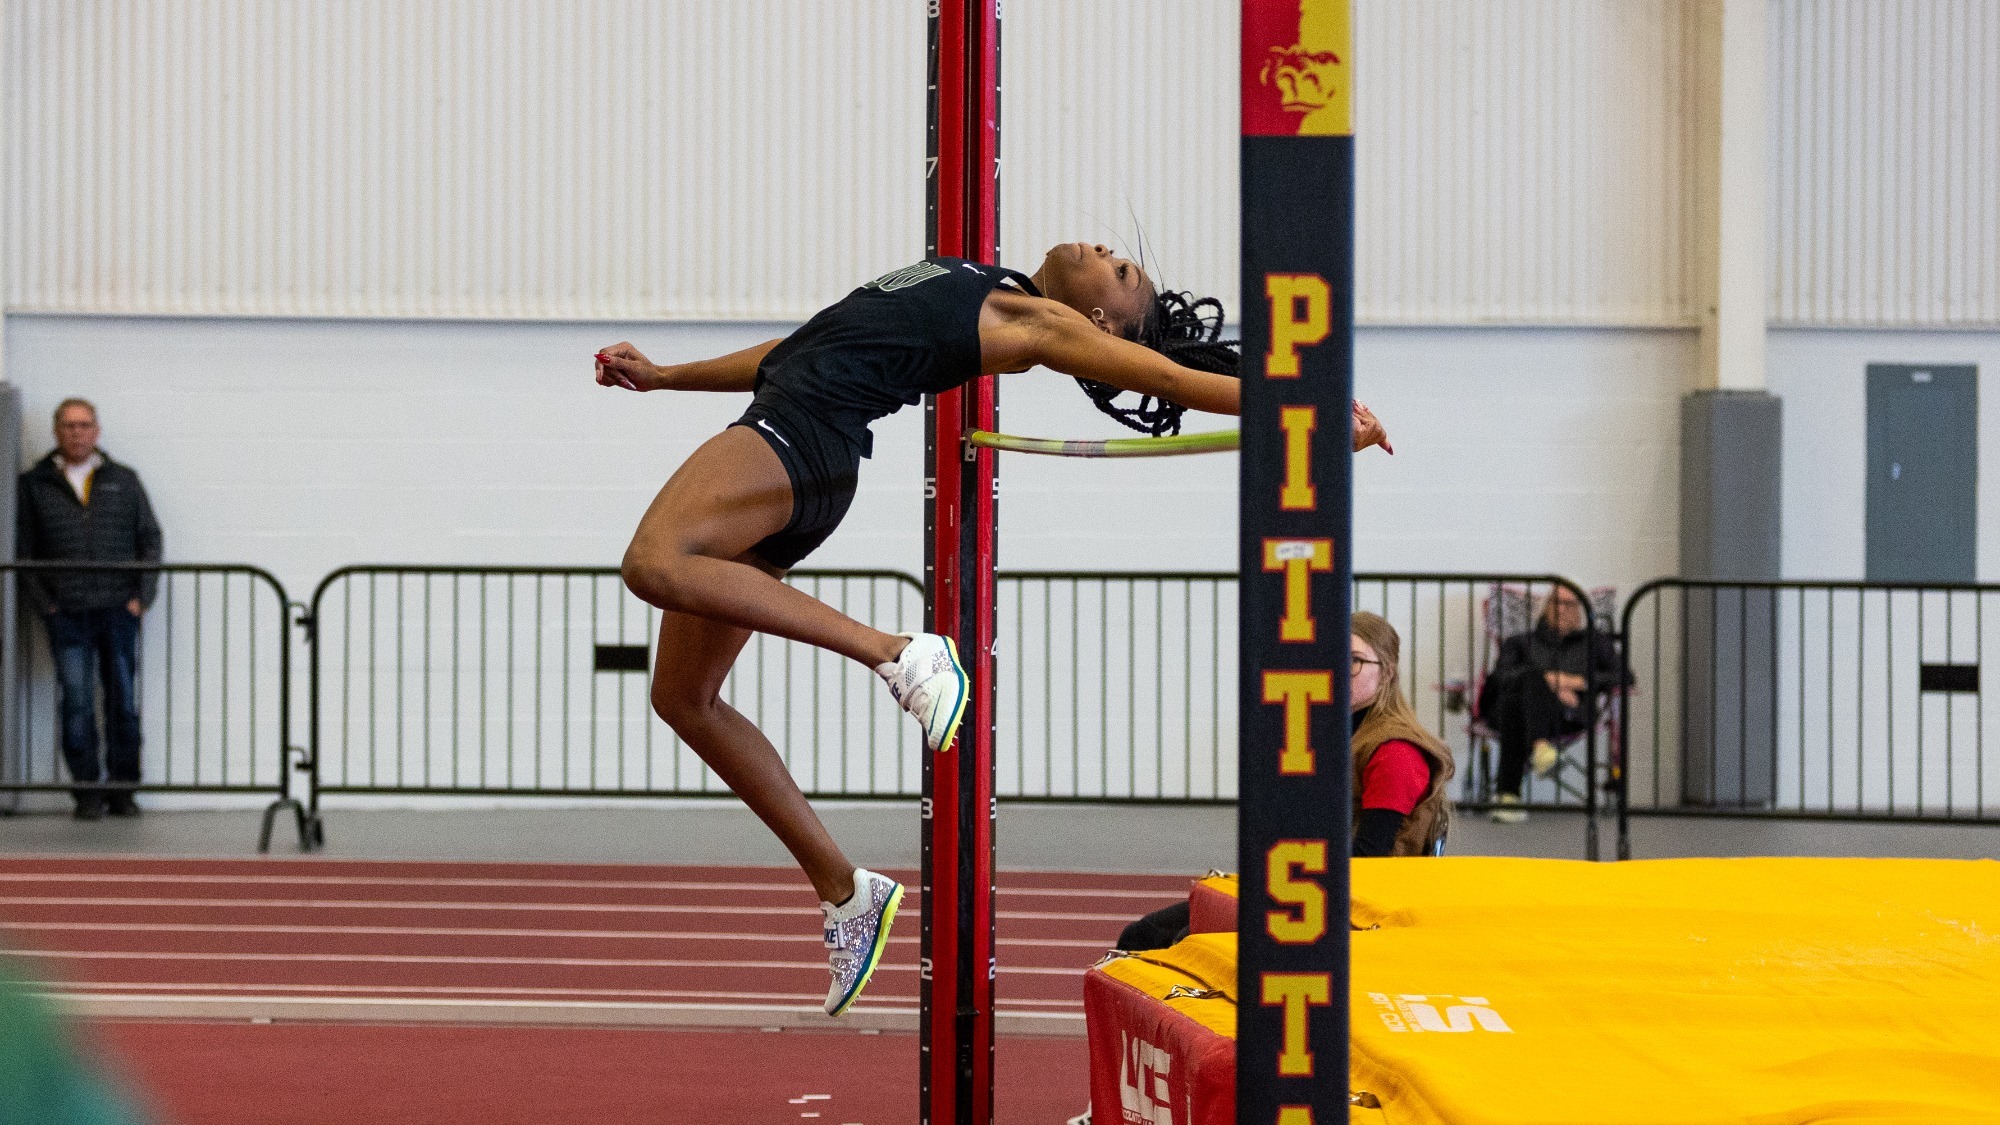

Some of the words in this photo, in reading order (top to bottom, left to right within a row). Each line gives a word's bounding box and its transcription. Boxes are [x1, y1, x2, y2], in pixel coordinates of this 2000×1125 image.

[927, 0, 940, 18] 8
[926, 157, 938, 178] 7
[924, 478, 936, 499] 5
[1262, 272, 1333, 775] PITT
[922, 797, 933, 819] 3
[921, 957, 932, 980] 2
[1260, 839, 1331, 1125] ST
